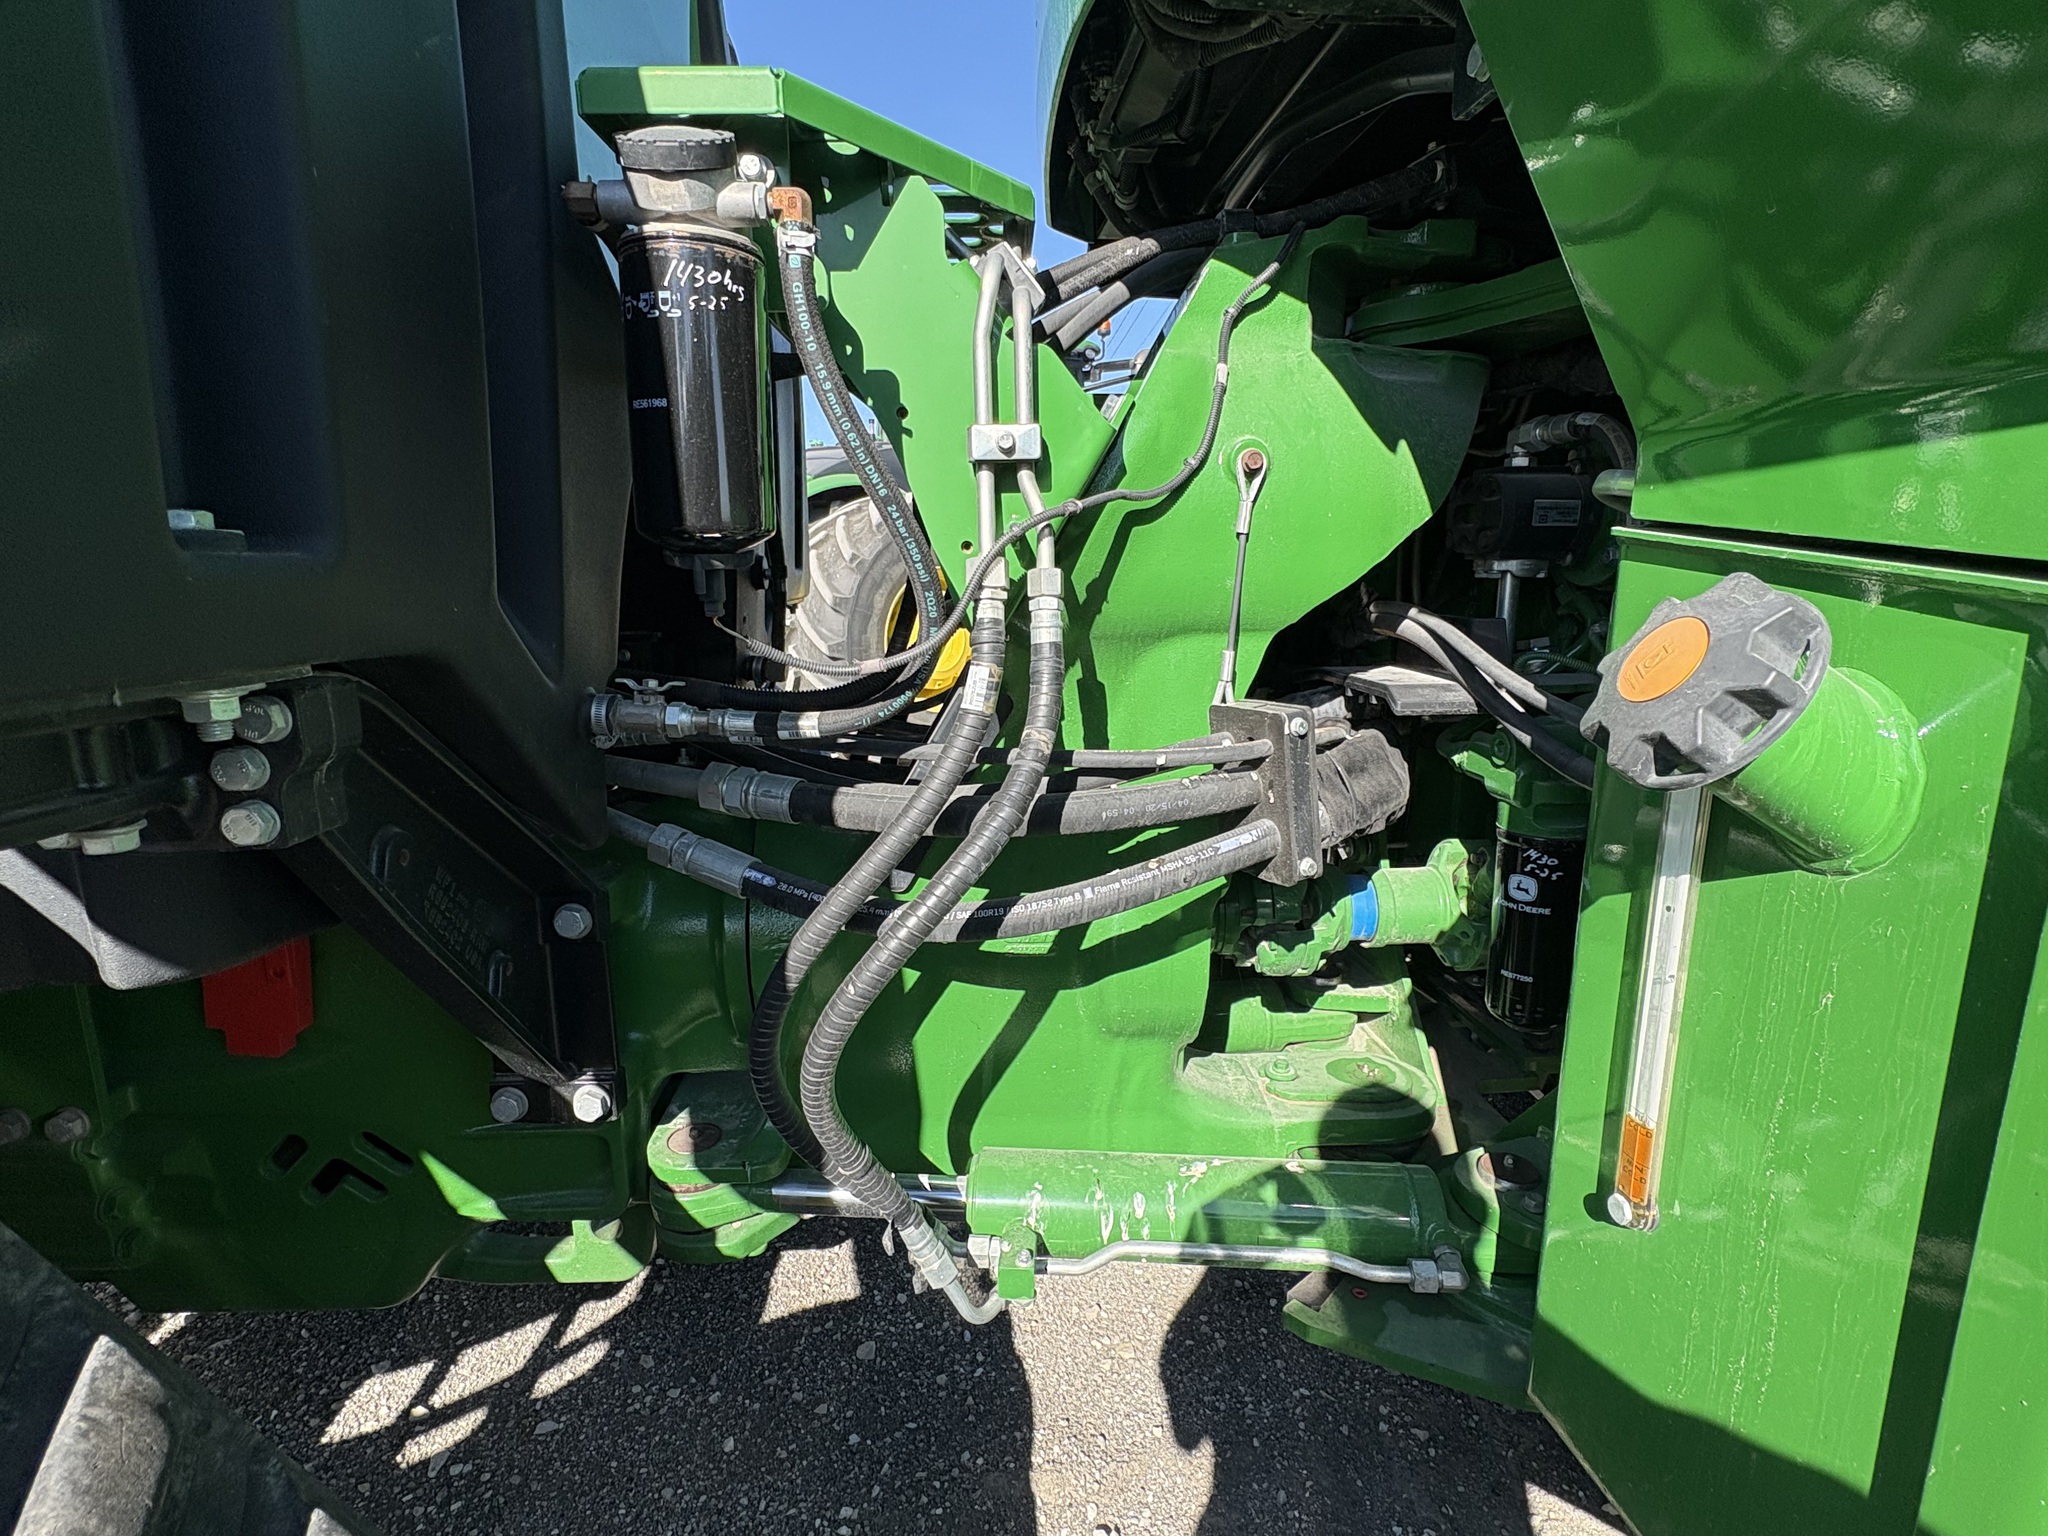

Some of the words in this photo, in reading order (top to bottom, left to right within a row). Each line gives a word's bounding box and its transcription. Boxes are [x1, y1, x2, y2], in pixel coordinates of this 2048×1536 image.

[792, 281, 817, 352] GH100-10
[865, 464, 888, 497] DN16
[1522, 848, 1559, 865] 1430
[973, 907, 1004, 918] 100R19
[1027, 899, 1053, 911] 18752
[1054, 895, 1073, 906] Type
[1094, 882, 1120, 895] Flame
[1121, 868, 1160, 887] Resistant
[1160, 859, 1185, 874] MSHA
[1518, 903, 1552, 915] DEERE
[1628, 1120, 1653, 1139] COLD
